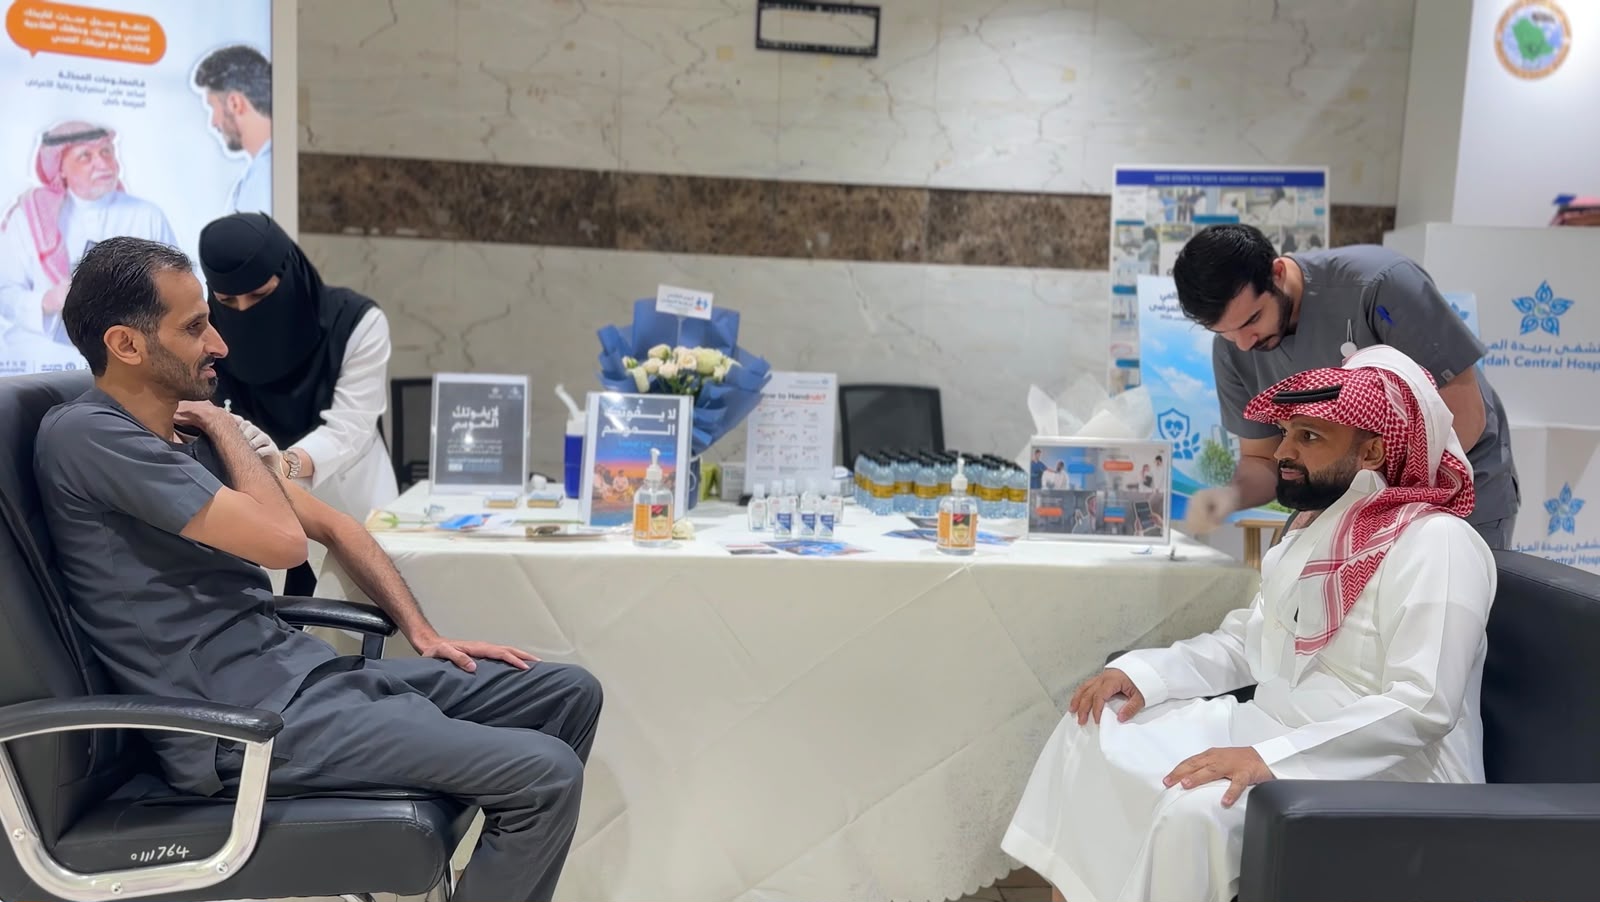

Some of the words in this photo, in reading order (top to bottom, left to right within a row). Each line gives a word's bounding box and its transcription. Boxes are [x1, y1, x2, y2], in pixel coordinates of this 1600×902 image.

[1488, 339, 1508, 351] الم
[1511, 340, 1552, 354] بريدة
[1514, 355, 1563, 370] Central
[778, 391, 787, 400] to
[601, 423, 676, 438] الموسم
